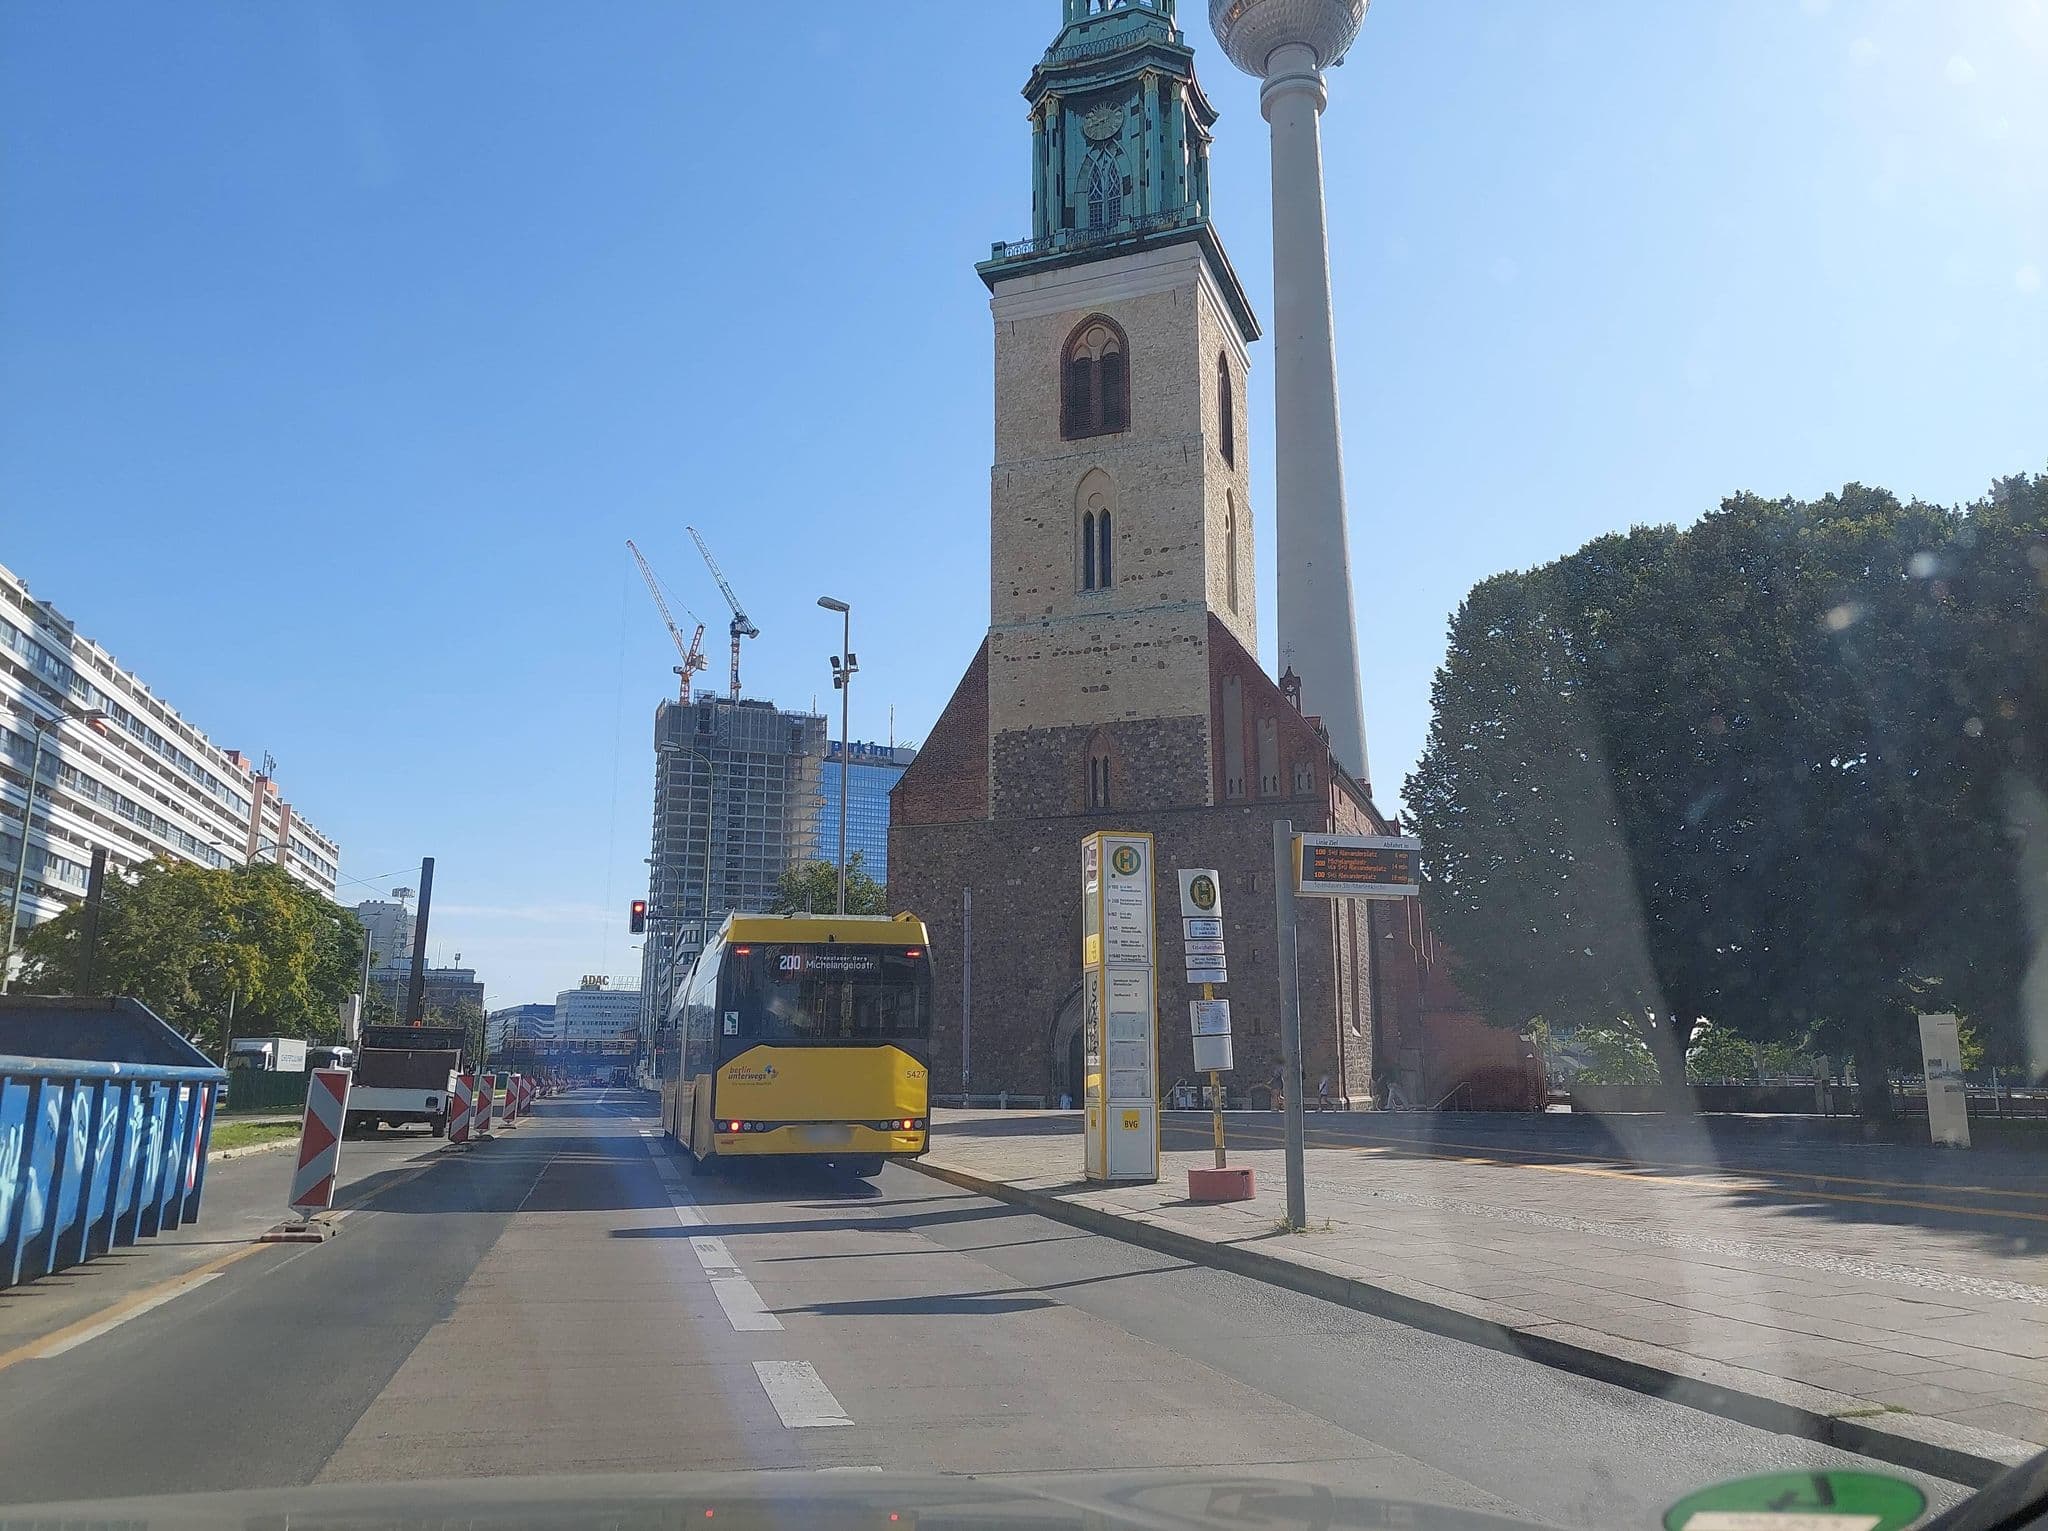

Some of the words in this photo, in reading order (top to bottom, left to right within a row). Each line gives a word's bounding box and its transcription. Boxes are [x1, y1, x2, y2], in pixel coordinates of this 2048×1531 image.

[779, 955, 801, 970] 200
[806, 960, 877, 971] Michelangelostr.
[581, 975, 610, 986] ADAC
[729, 1065, 752, 1073] berlin
[728, 1073, 766, 1081] unterwegs
[906, 1070, 925, 1079] 5427
[1124, 1120, 1138, 1128] BVG
